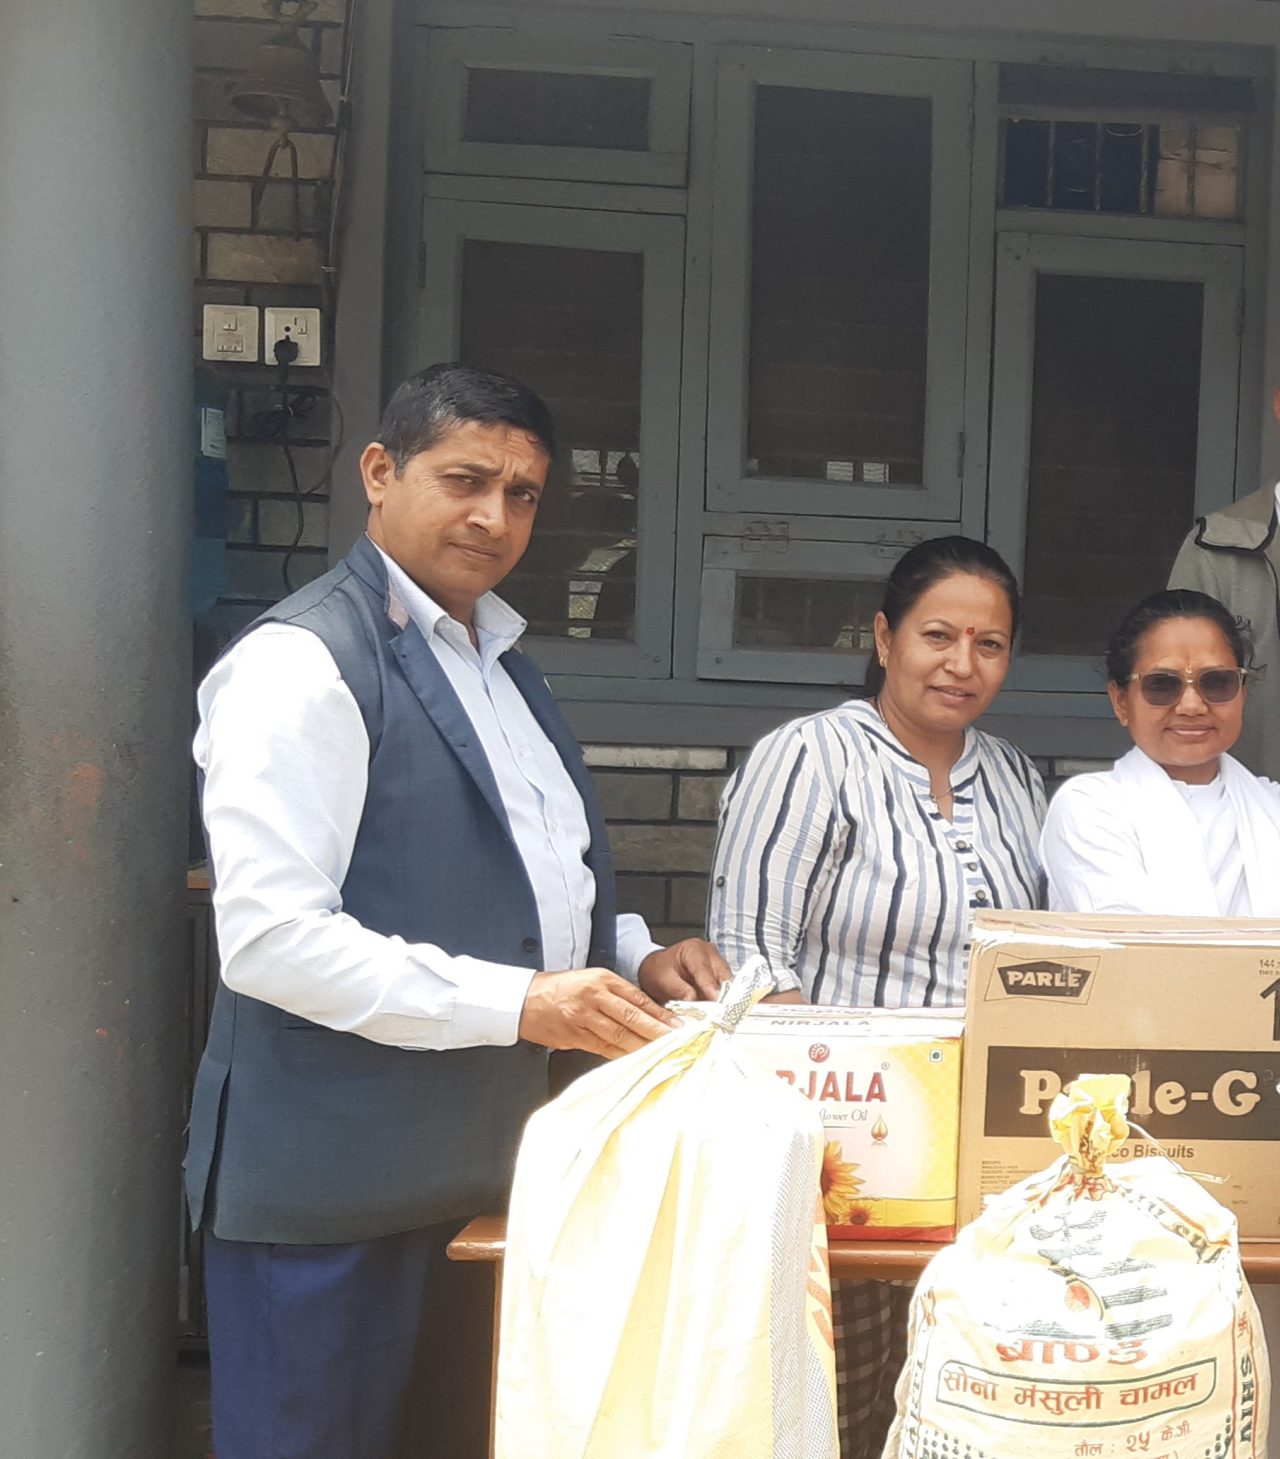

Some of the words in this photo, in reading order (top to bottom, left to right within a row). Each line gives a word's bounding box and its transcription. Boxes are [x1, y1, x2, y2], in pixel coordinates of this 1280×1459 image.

[1259, 960, 1274, 968] 144
[1007, 971, 1082, 988] PARLE
[1019, 1069, 1261, 1116] Ple-G
[851, 1108, 868, 1121] Oil
[943, 1366, 1000, 1401] सोना
[1119, 1372, 1199, 1406] चामल
[1074, 1438, 1103, 1457] तौल
[1126, 1430, 1152, 1452] २५
